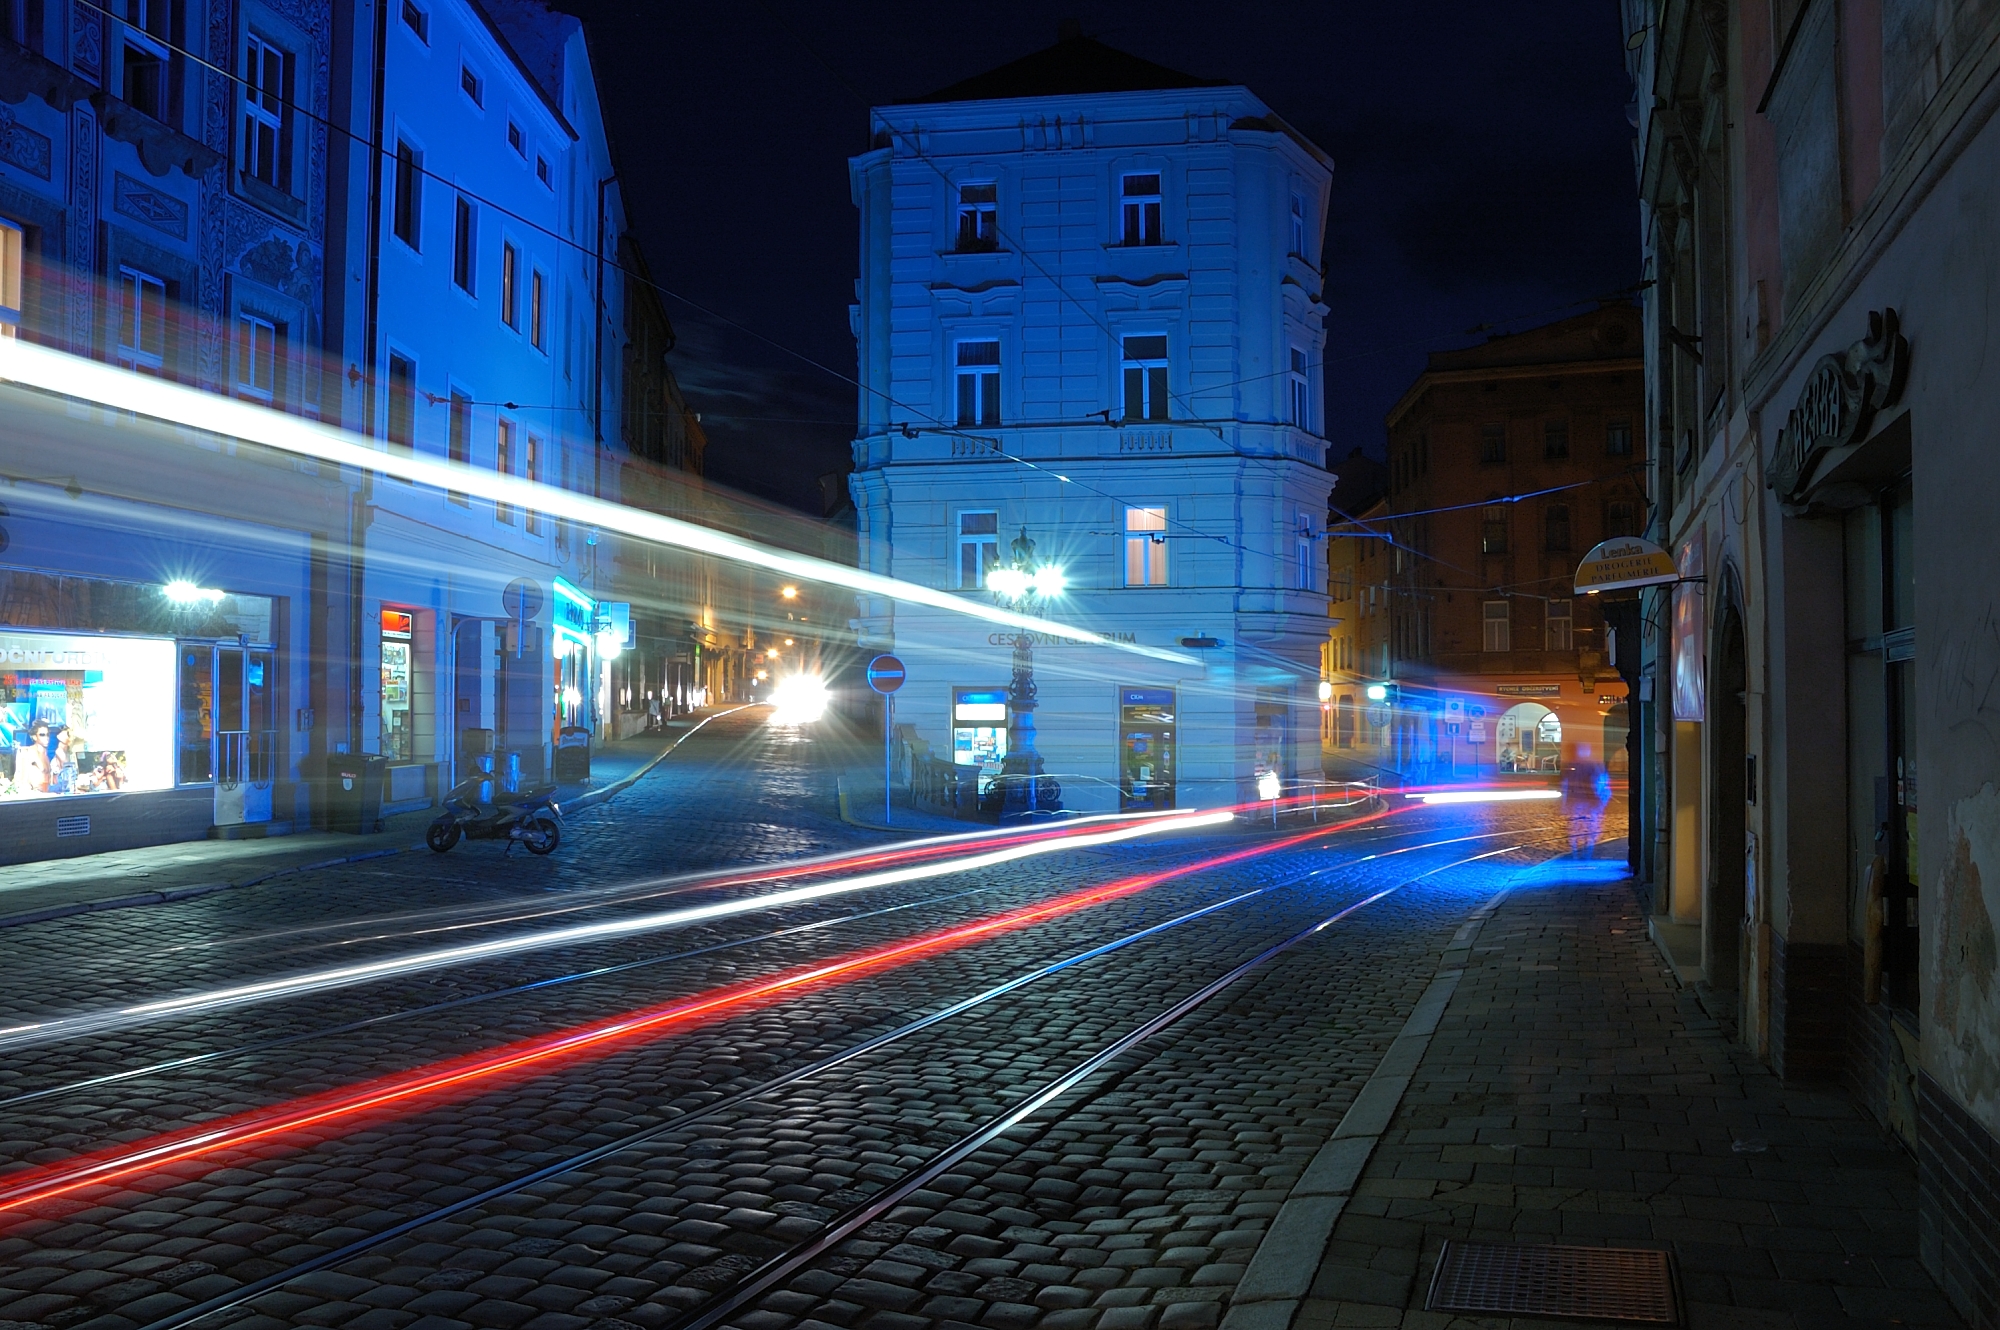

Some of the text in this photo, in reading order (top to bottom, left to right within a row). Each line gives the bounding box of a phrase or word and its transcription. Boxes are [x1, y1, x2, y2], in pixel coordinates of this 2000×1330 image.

[1600, 543, 1643, 559] Lenka
[1596, 557, 1652, 572] DROGERIE
[1591, 567, 1659, 583] PARFUMERIE
